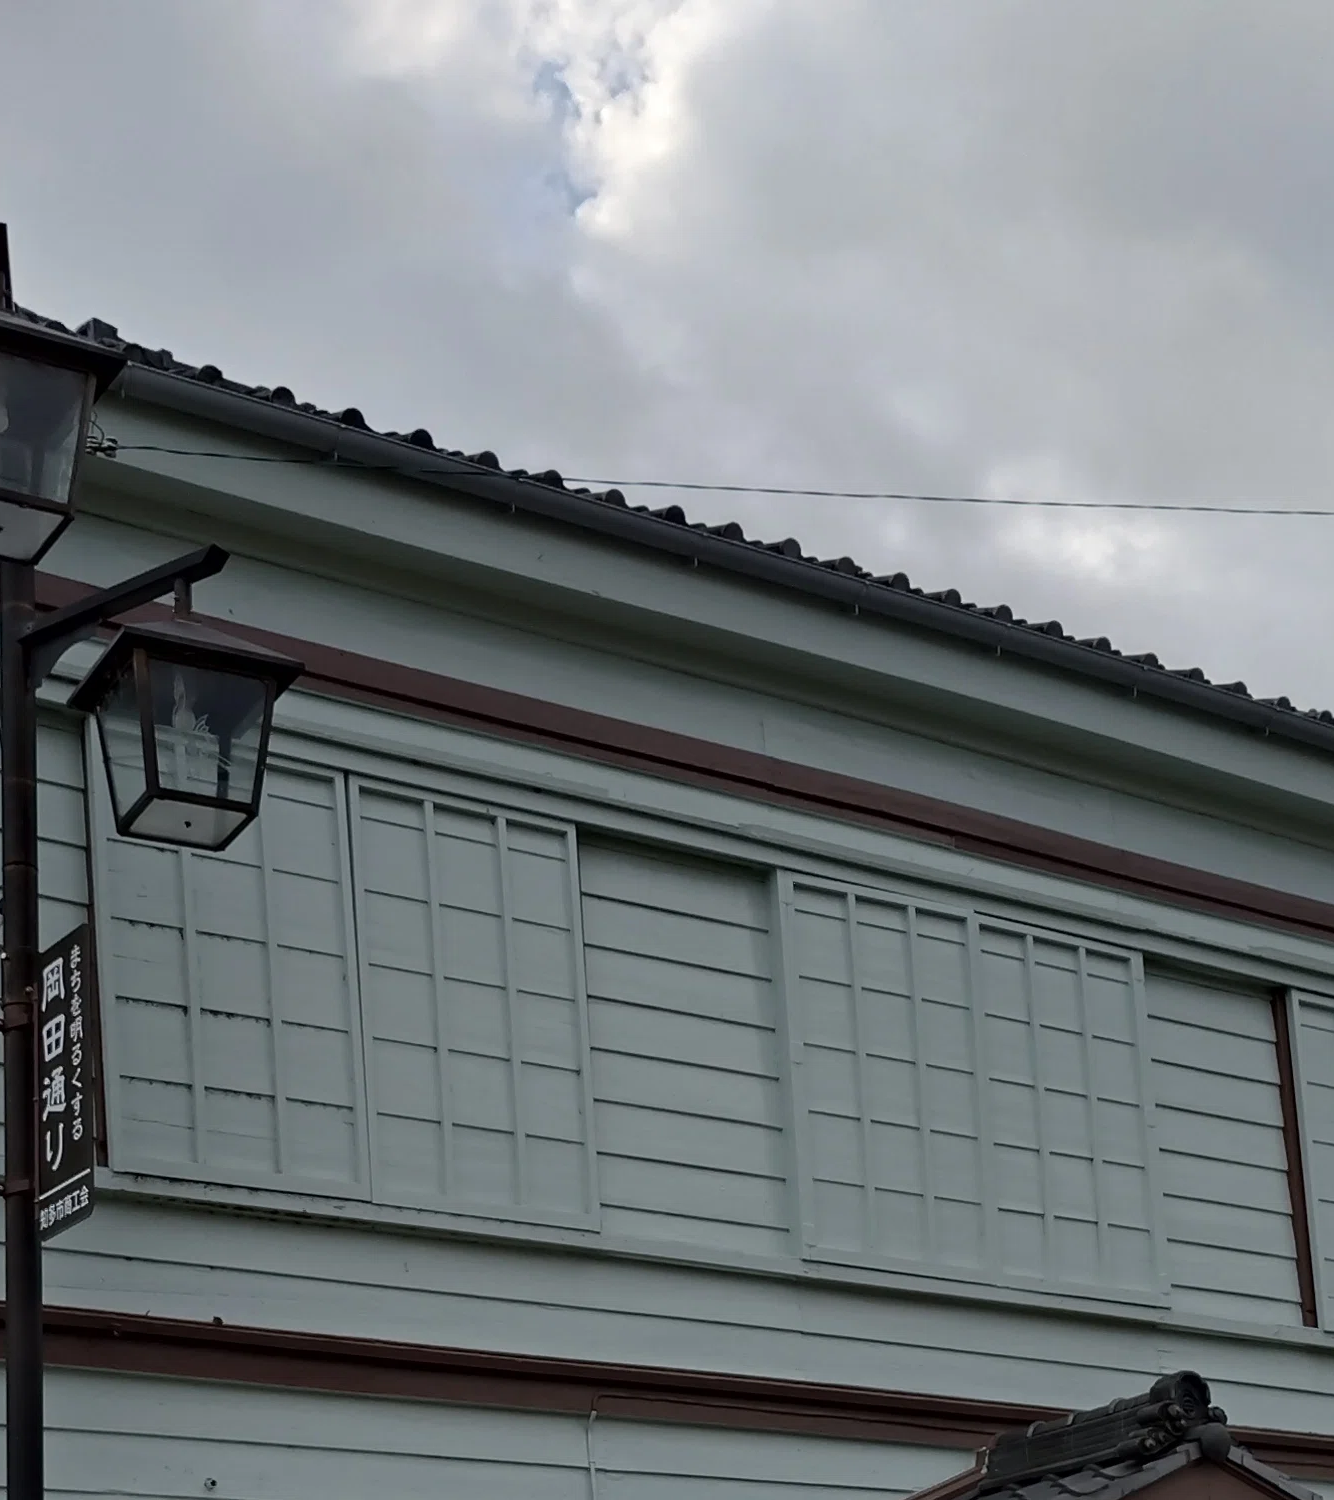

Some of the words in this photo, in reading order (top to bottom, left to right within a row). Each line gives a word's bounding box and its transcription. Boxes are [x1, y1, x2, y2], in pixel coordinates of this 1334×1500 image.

[41, 956, 66, 1172] 岡田通り
[69, 944, 83, 1141] まちを明るくする
[39, 1184, 89, 1231] 知多市商工会
